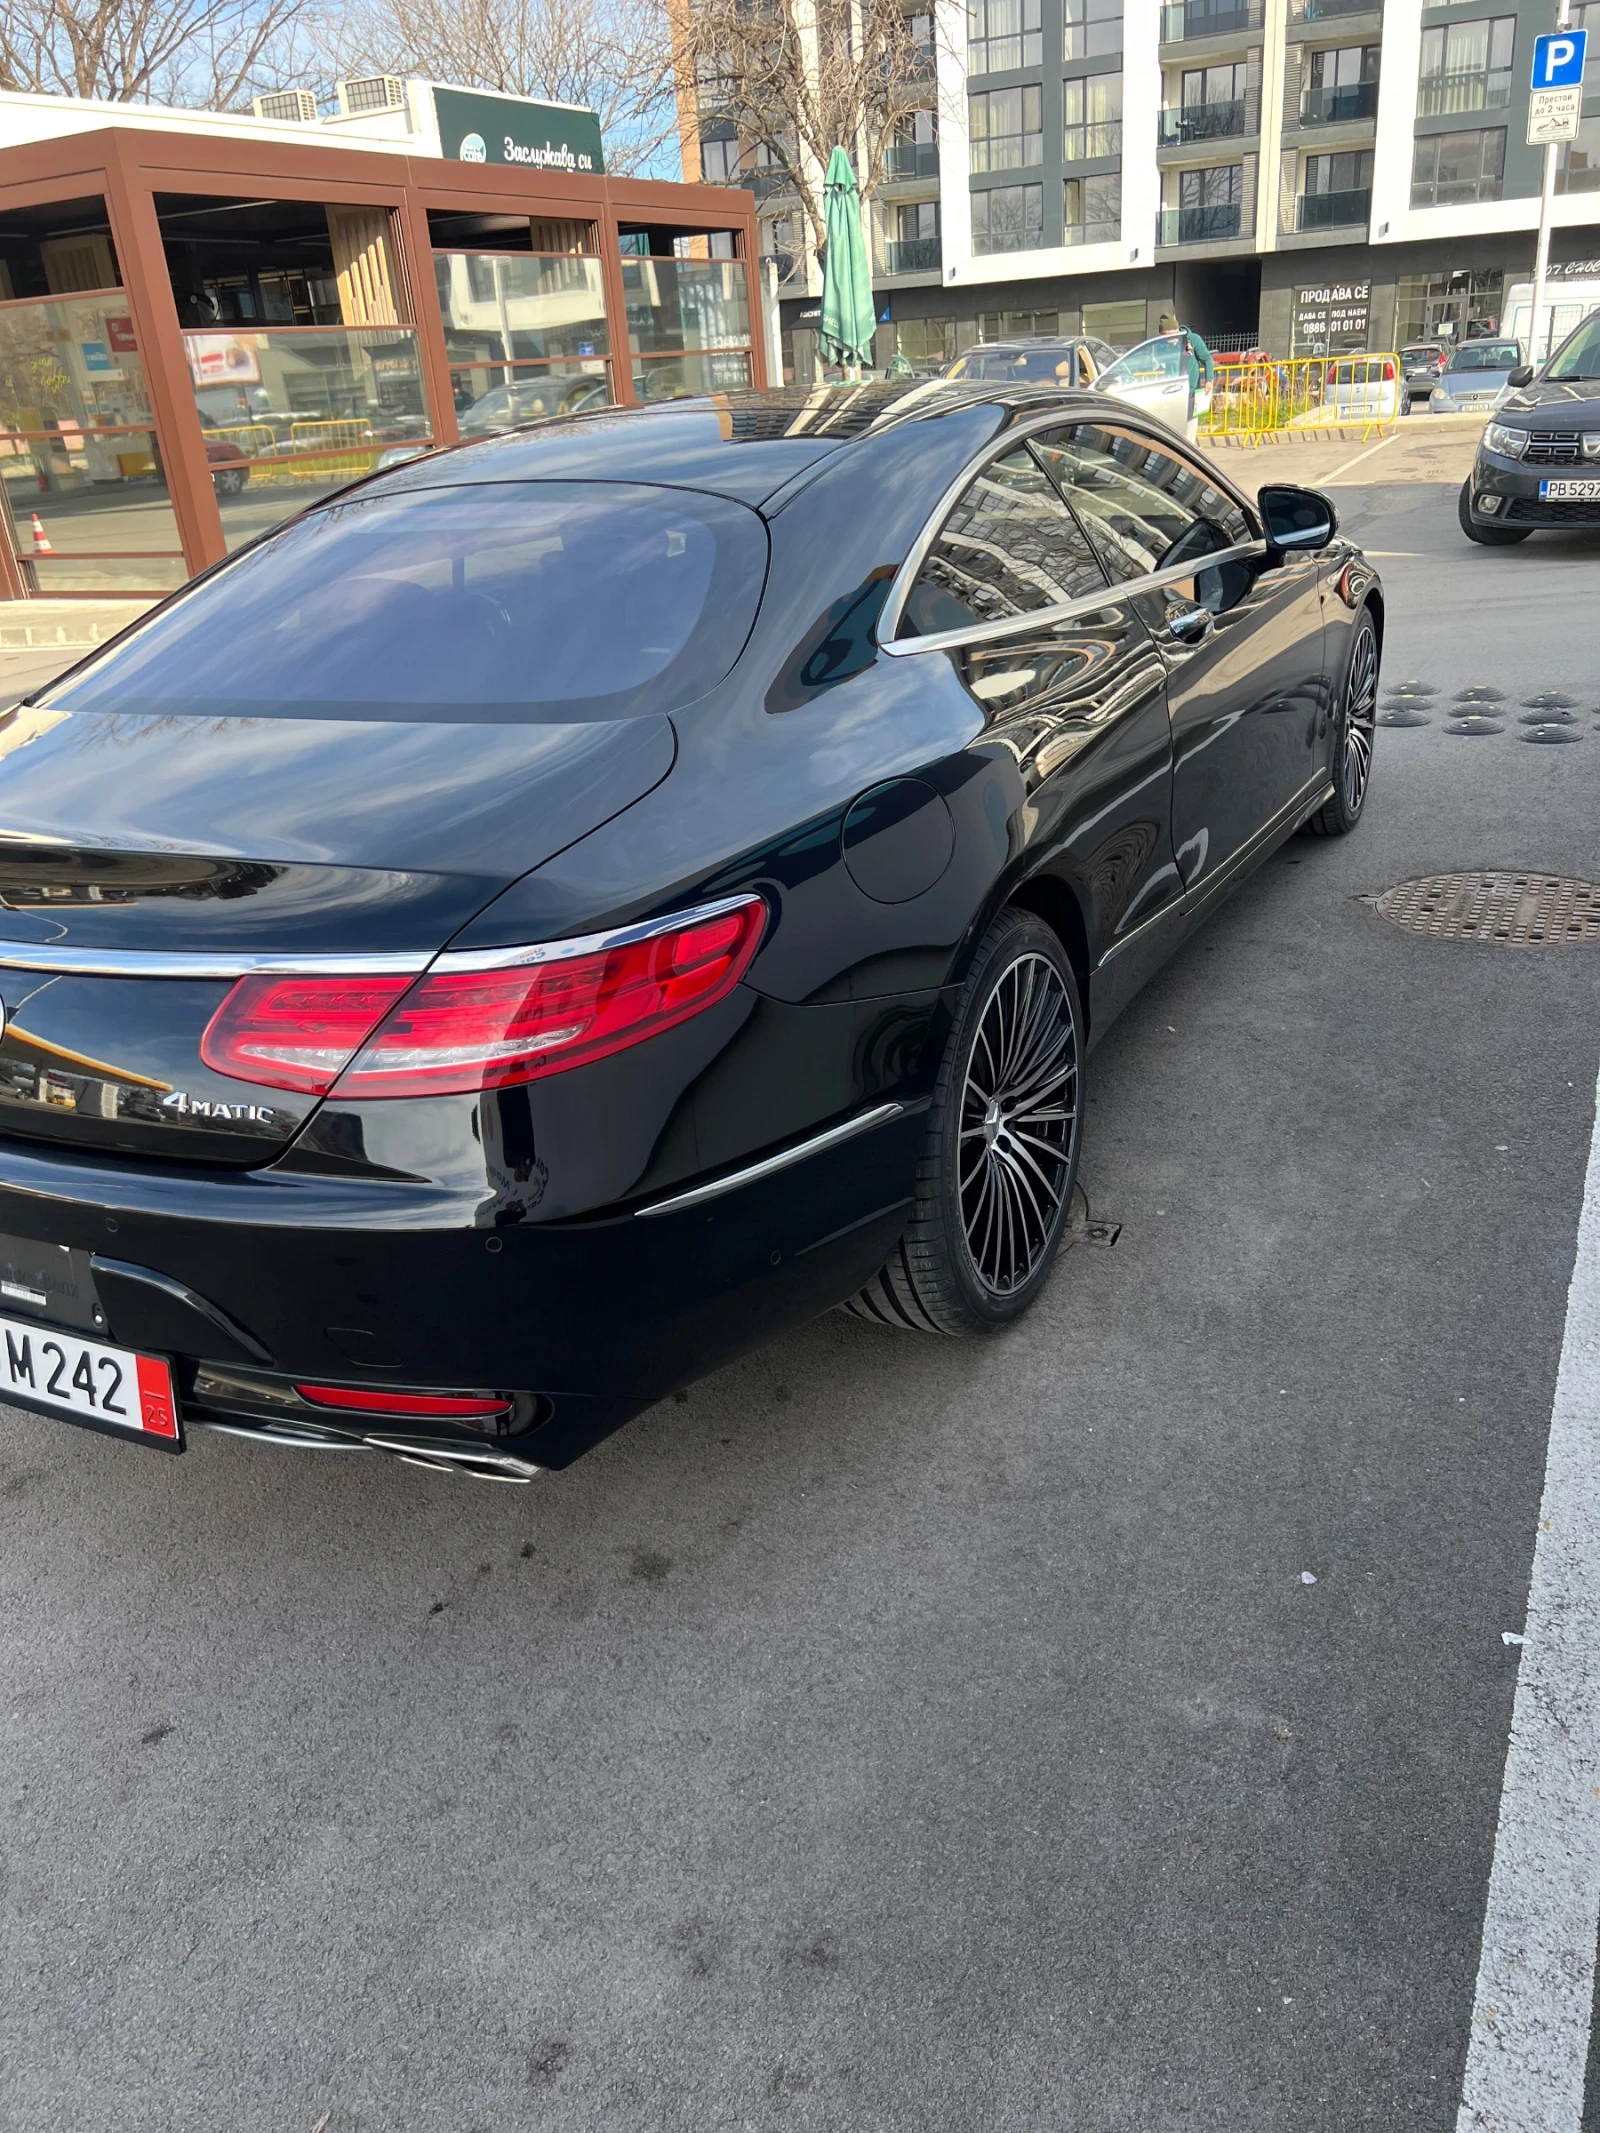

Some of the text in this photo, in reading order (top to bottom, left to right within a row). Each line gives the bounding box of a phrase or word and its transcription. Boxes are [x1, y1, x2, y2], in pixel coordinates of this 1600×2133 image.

[1545, 40, 1574, 81] P
[1539, 94, 1573, 105] Престой
[1548, 105, 1553, 113] 2
[578, 156, 592, 170] си
[1300, 286, 1369, 303] ПРОДАВА СЕ
[1298, 308, 1367, 321] ДАВА СЕ ПОД НАЕМ
[1303, 319, 1366, 334] 0886 01 01 01
[162, 1091, 276, 1123] 4MATIC
[145, 1404, 168, 1426] 25
